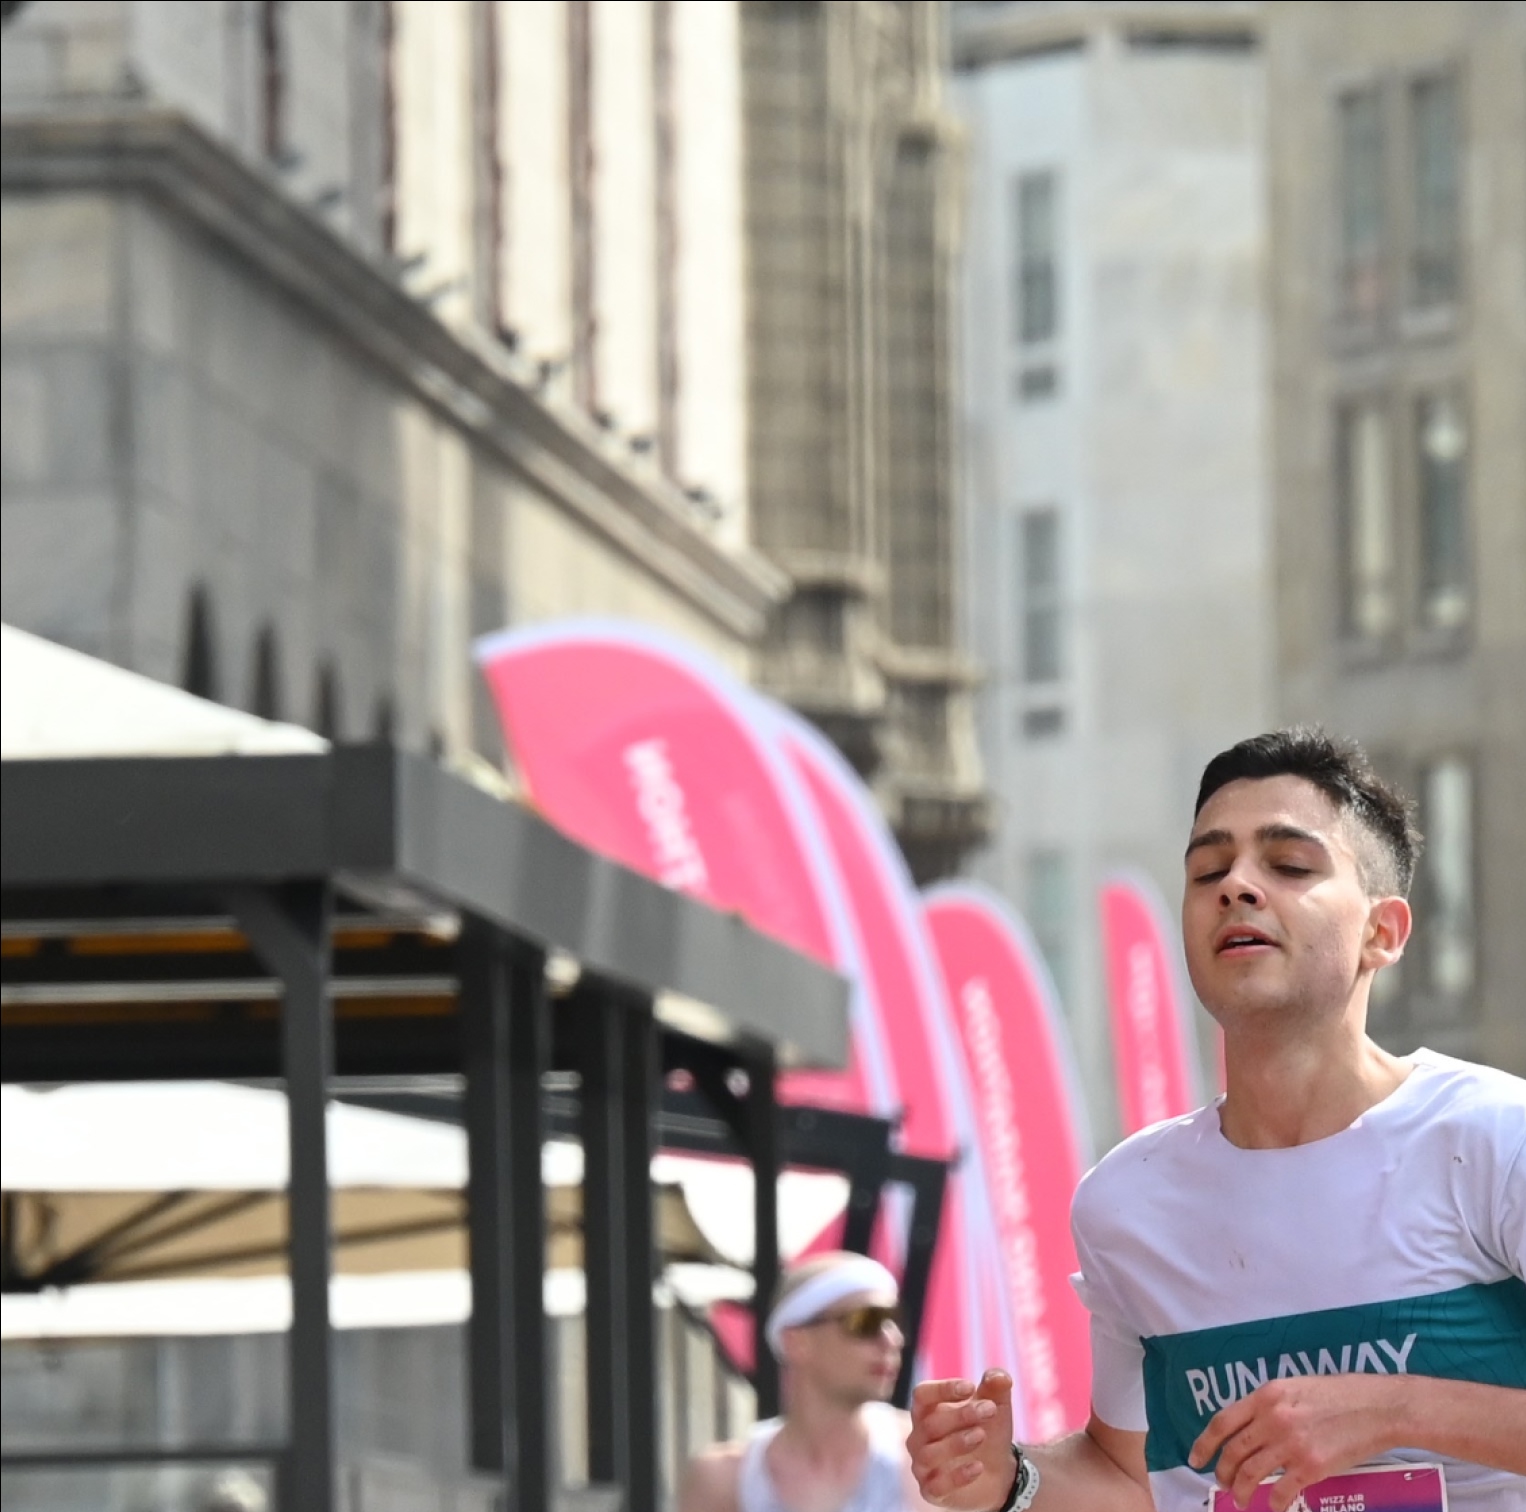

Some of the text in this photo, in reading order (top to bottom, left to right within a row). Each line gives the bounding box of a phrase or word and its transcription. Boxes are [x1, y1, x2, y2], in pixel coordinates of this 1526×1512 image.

[1185, 1333, 1417, 1417] RUNAWAY
[1319, 1493, 1364, 1506] WIZZ AIR
